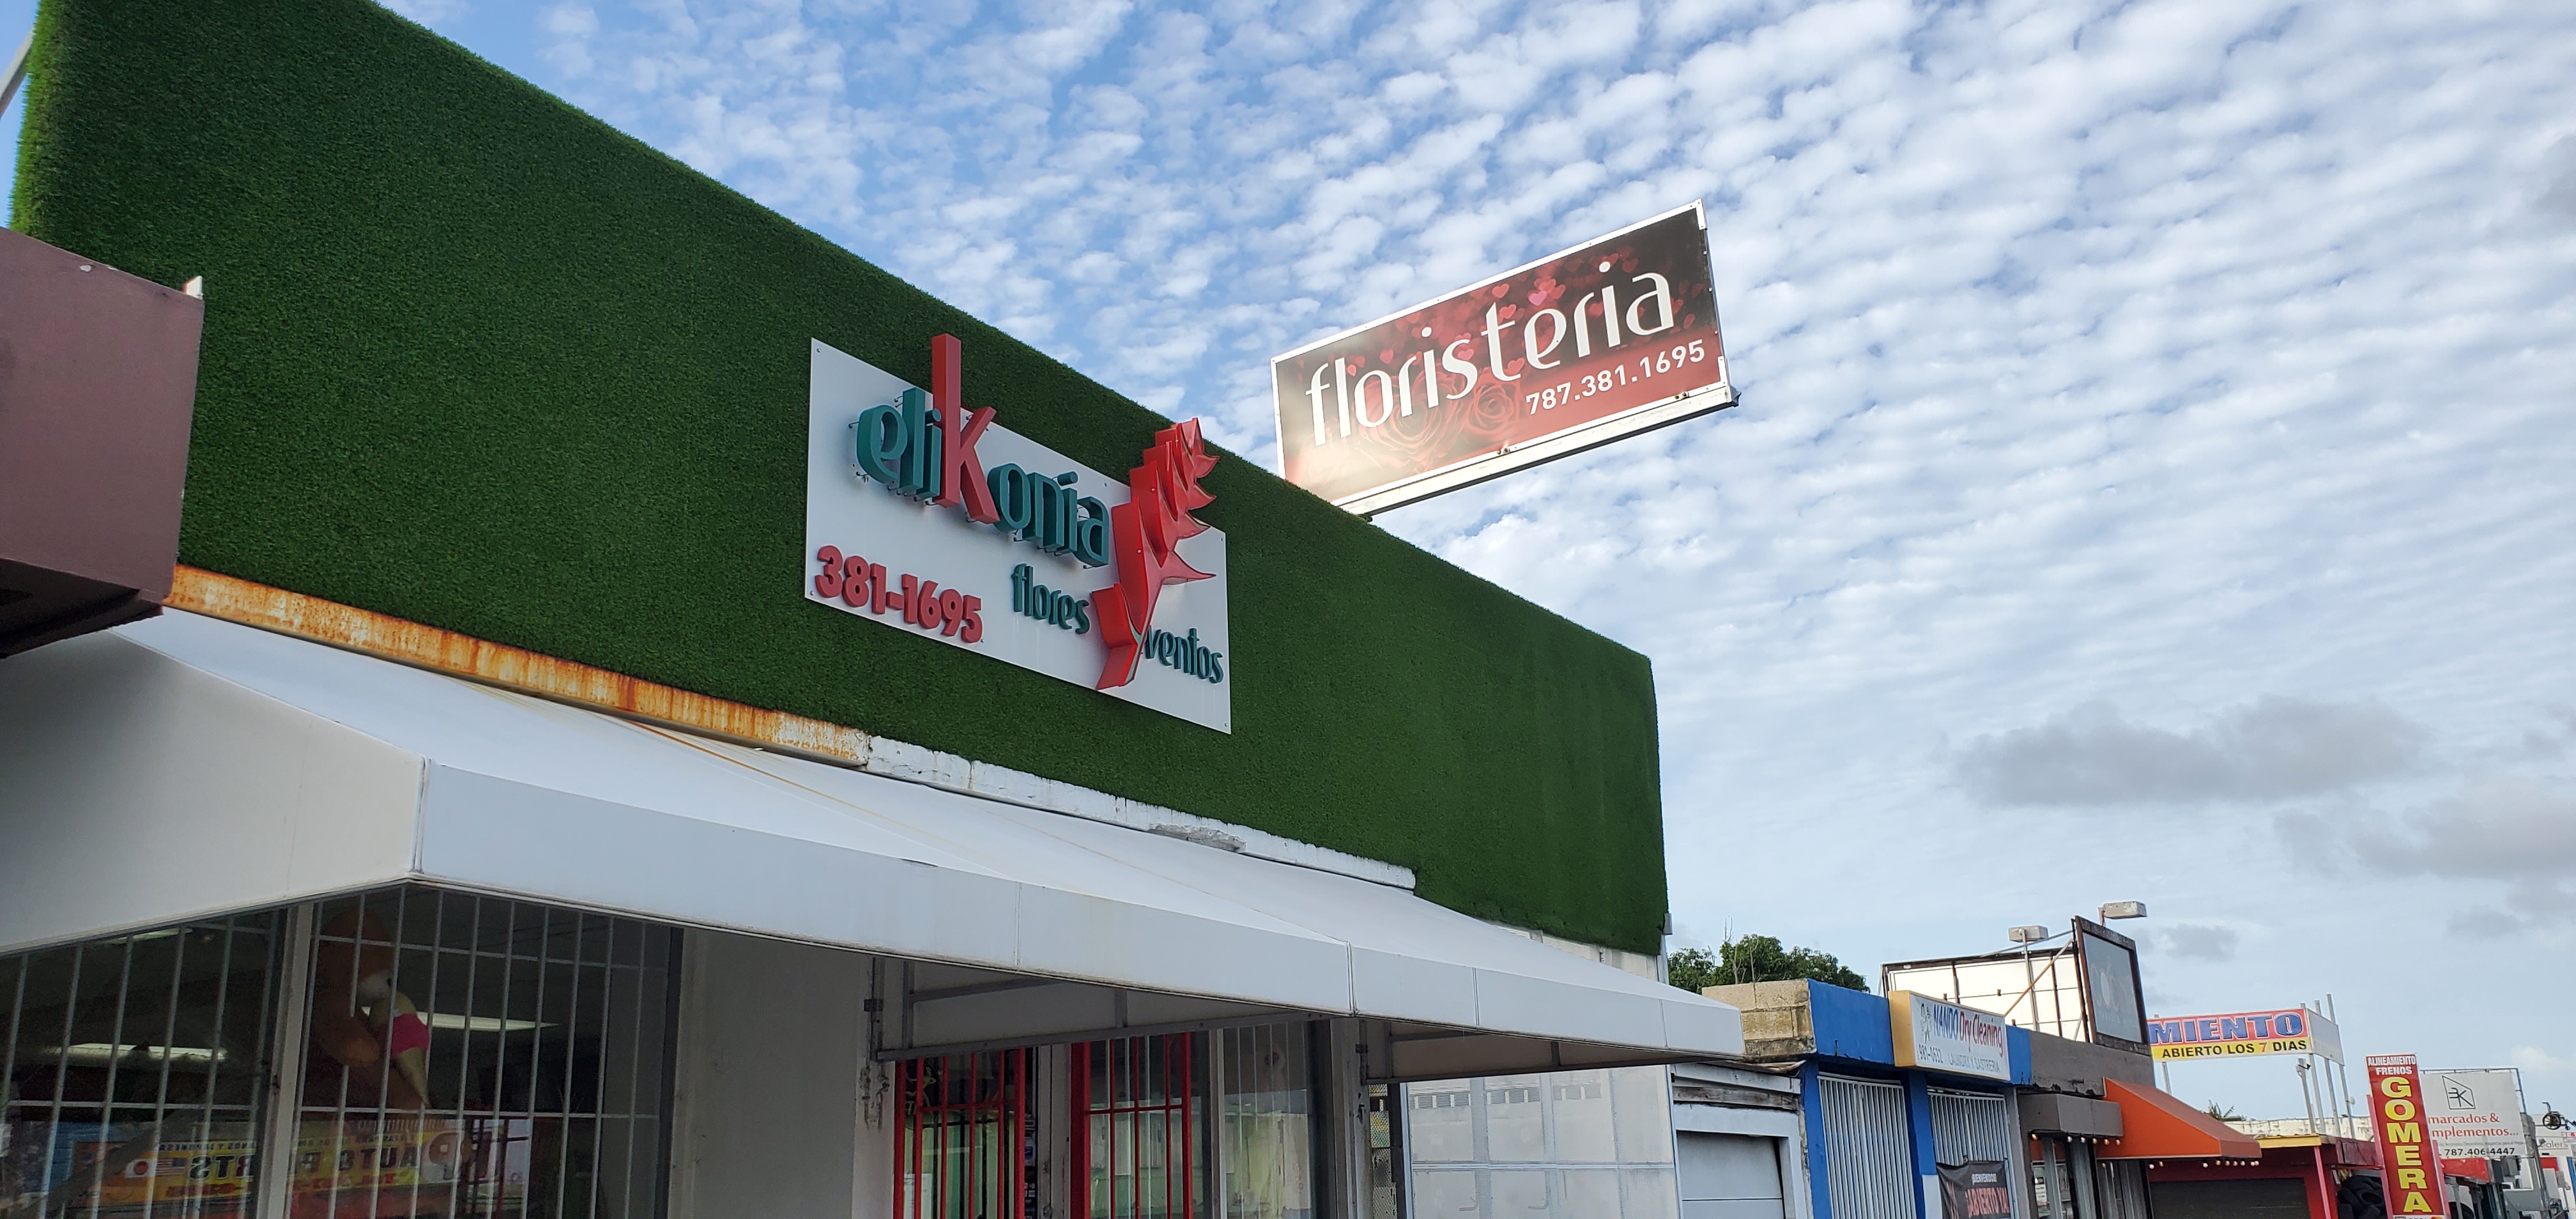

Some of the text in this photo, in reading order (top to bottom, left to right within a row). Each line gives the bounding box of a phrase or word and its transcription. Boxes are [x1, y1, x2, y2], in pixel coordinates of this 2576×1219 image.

[1305, 261, 1675, 446] floristeria
[1526, 339, 1705, 415] 787.381.1695
[815, 545, 983, 643] 381-1695
[1011, 563, 1090, 634] flores
[1933, 1004, 2004, 1058] NANDO Dry Cleaning
[2148, 1013, 2303, 1045] MIENTO
[2162, 1040, 2307, 1058] ABIERTO LOS 7 DIAS
[2367, 1055, 2416, 1066] ALINEAMIENTO
[2375, 1066, 2412, 1075] FRENOS
[2381, 1076, 2432, 1213] GOMERA
[2428, 1112, 2501, 1124] marcados &
